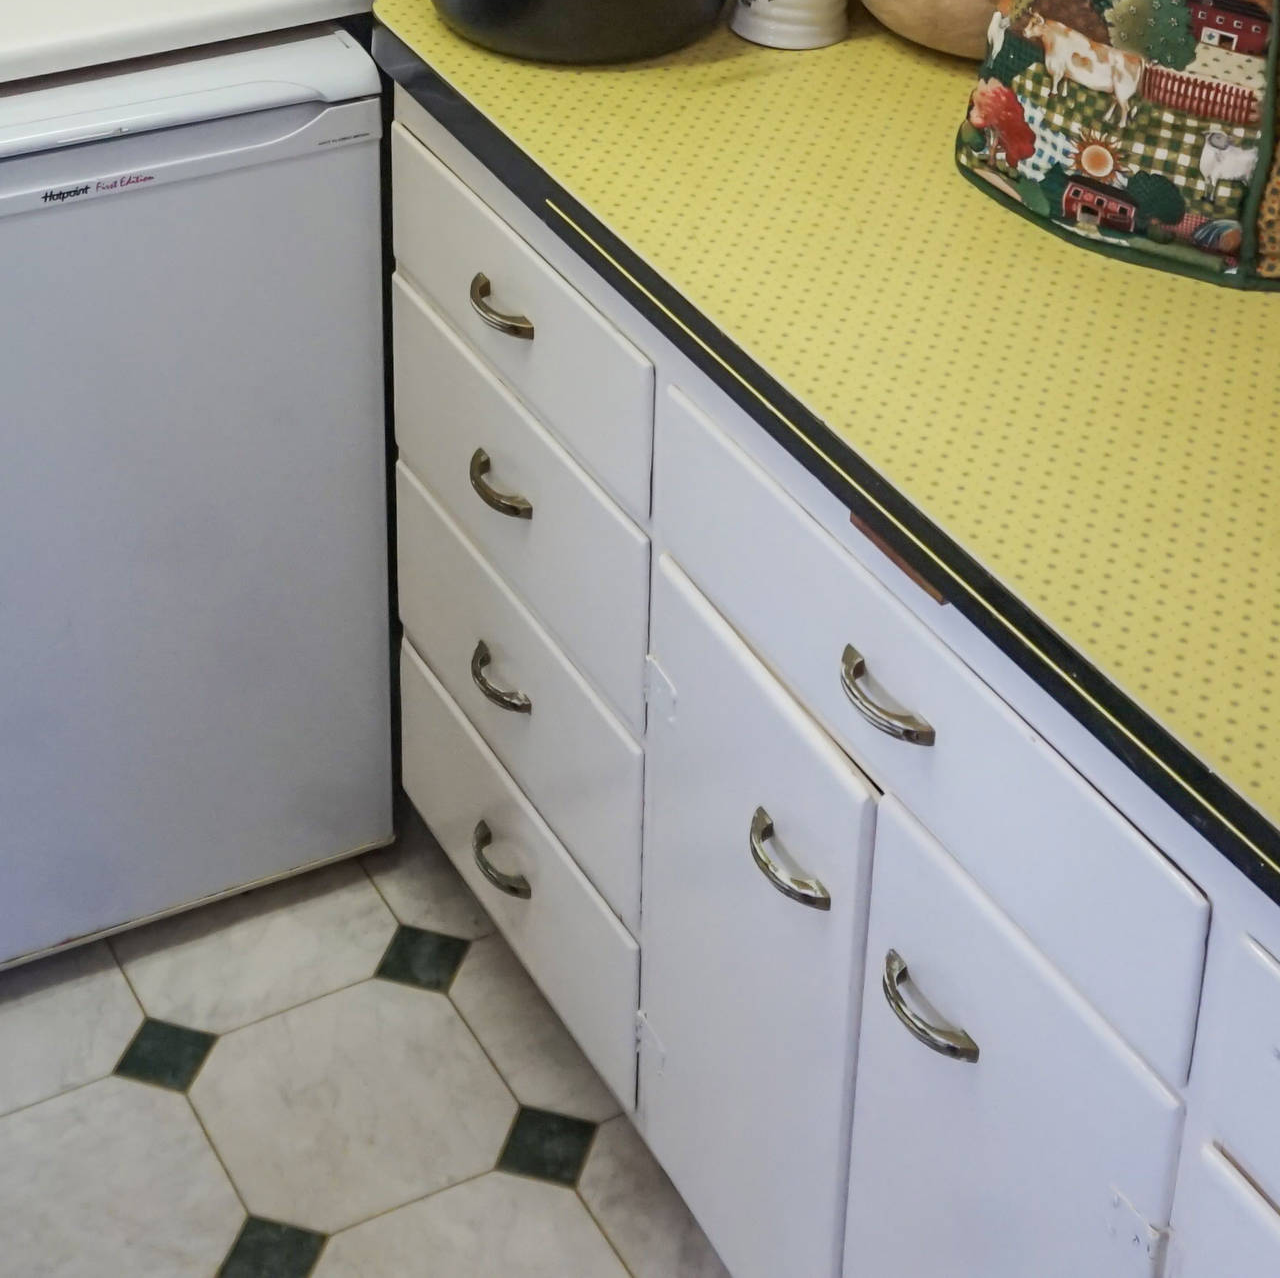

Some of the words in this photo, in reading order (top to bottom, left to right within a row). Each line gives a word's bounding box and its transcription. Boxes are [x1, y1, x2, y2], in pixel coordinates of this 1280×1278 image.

[41, 184, 91, 202] Hotpoint
[95, 181, 118, 192] First
[120, 175, 155, 187] Edition
